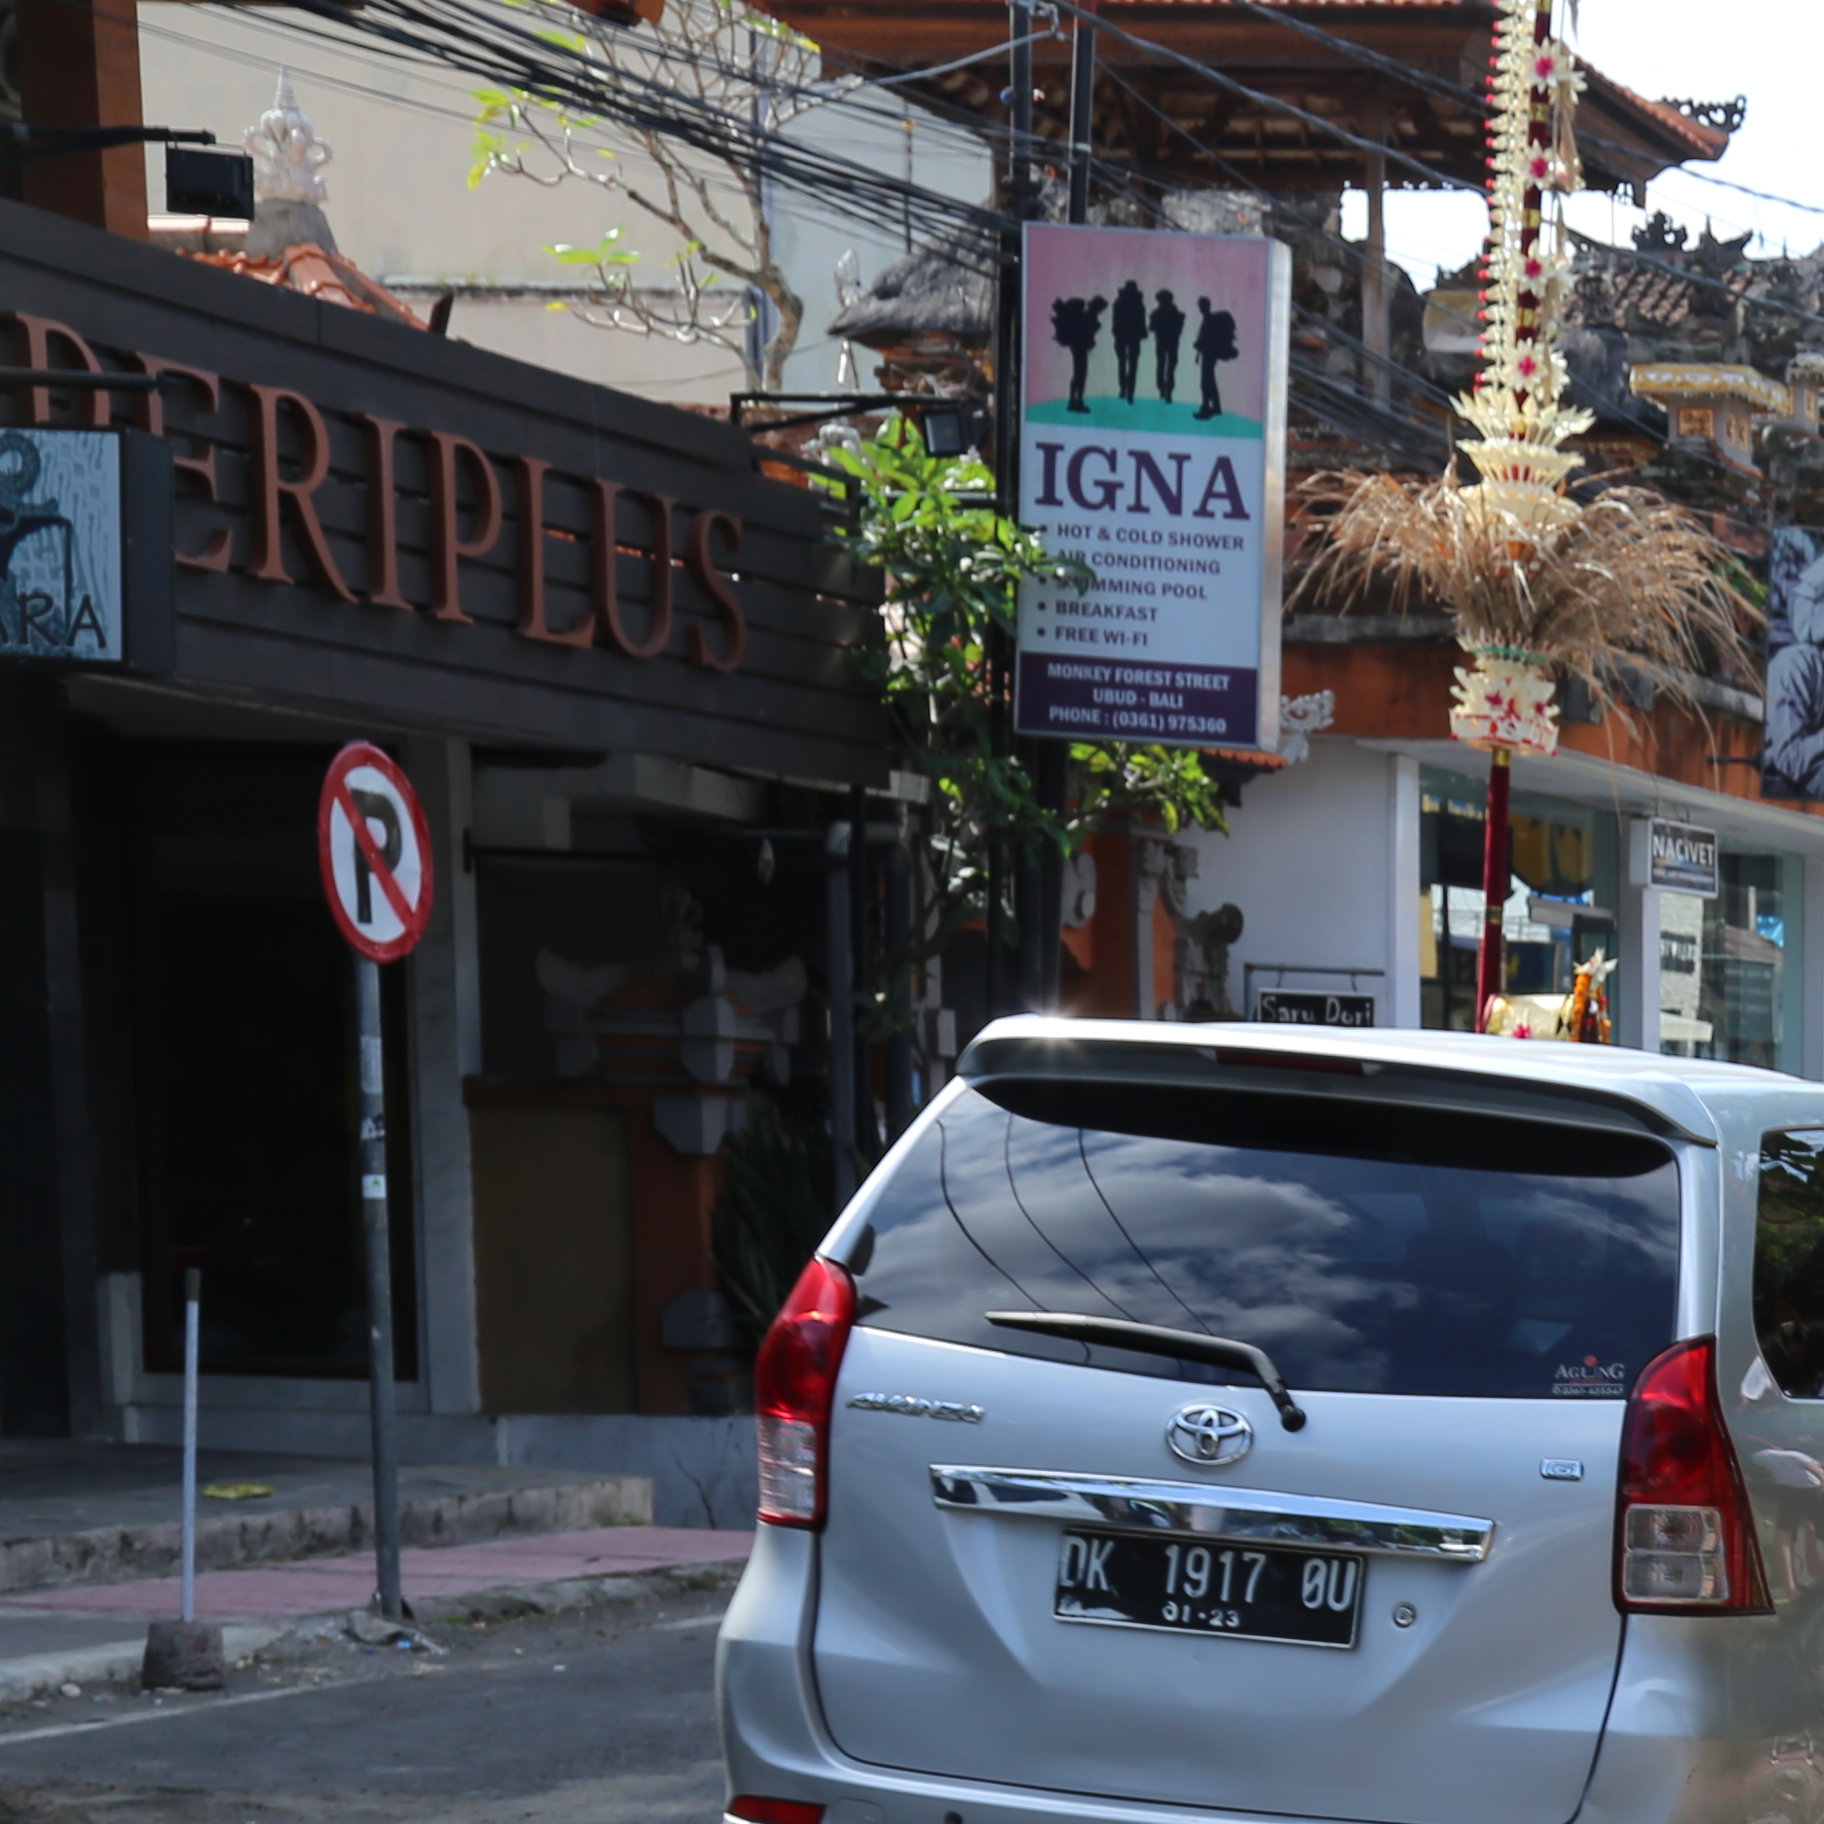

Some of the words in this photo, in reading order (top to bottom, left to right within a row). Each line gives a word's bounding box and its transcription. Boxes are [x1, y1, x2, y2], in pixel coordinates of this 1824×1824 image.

[1035, 441, 1250, 520] IGNA
[1057, 523, 1092, 539] HOT
[1097, 528, 1110, 541] &
[1115, 529, 1163, 546] COLD
[1168, 532, 1245, 550] SHOWER
[1091, 551, 1221, 575] CONDITIONING
[1055, 571, 1156, 597] SMMING
[1162, 582, 1208, 600] POOL
[0, 593, 106, 649] RA
[1055, 601, 1158, 622] BREAKFAST
[1055, 626, 1098, 644] FREE
[1103, 630, 1149, 647] WI-FI
[1047, 662, 1111, 683] MONKEY
[1114, 669, 1171, 688] FOREST
[1174, 674, 1230, 691] STREET
[1093, 687, 1137, 707] UBUD
[1149, 691, 1183, 709] BALI
[1049, 706, 1100, 725] PHONE
[1112, 710, 1165, 732] (0361)
[1168, 716, 1227, 734] 975360
[1553, 1362, 1626, 1380] AGUNG
[1059, 1535, 1115, 1592] DK
[1164, 1543, 1267, 1604] 1917
